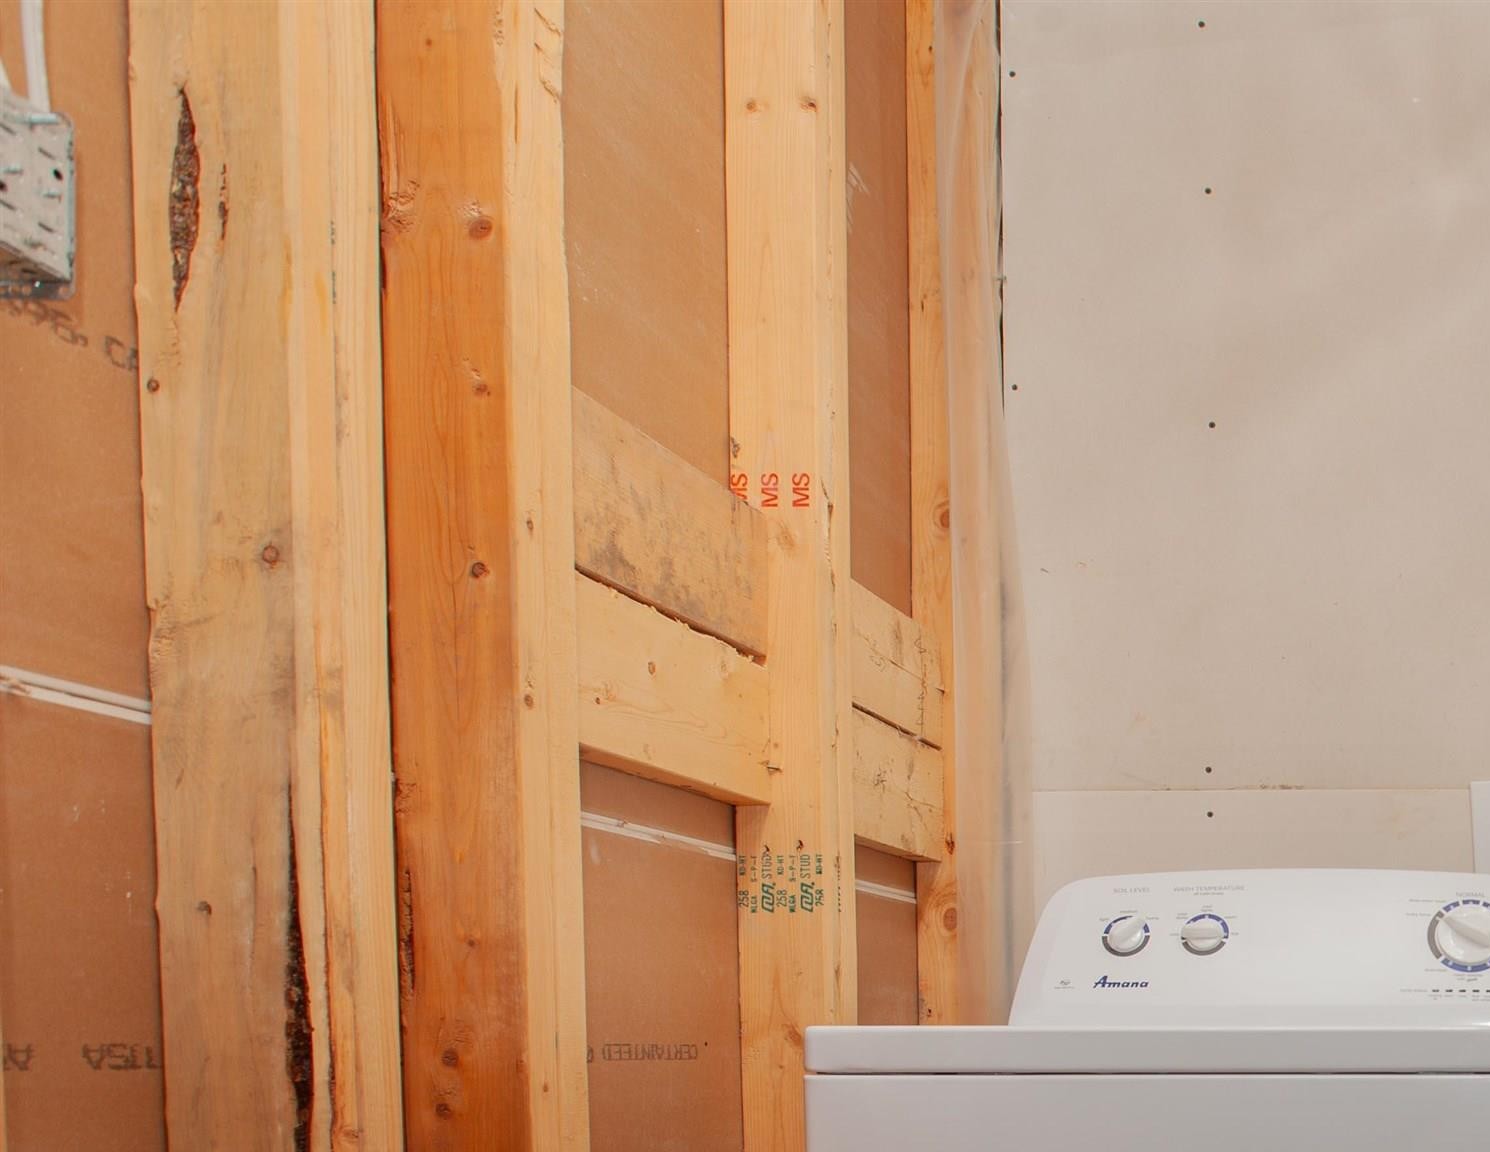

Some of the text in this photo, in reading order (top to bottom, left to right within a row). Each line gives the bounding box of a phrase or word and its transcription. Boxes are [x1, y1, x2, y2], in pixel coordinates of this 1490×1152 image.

[761, 473, 778, 507] MS
[791, 473, 810, 507] MS
[800, 854, 811, 879] STUD
[738, 890, 749, 908] 258
[776, 889, 787, 907] 258
[1093, 975, 1149, 989] Amana
